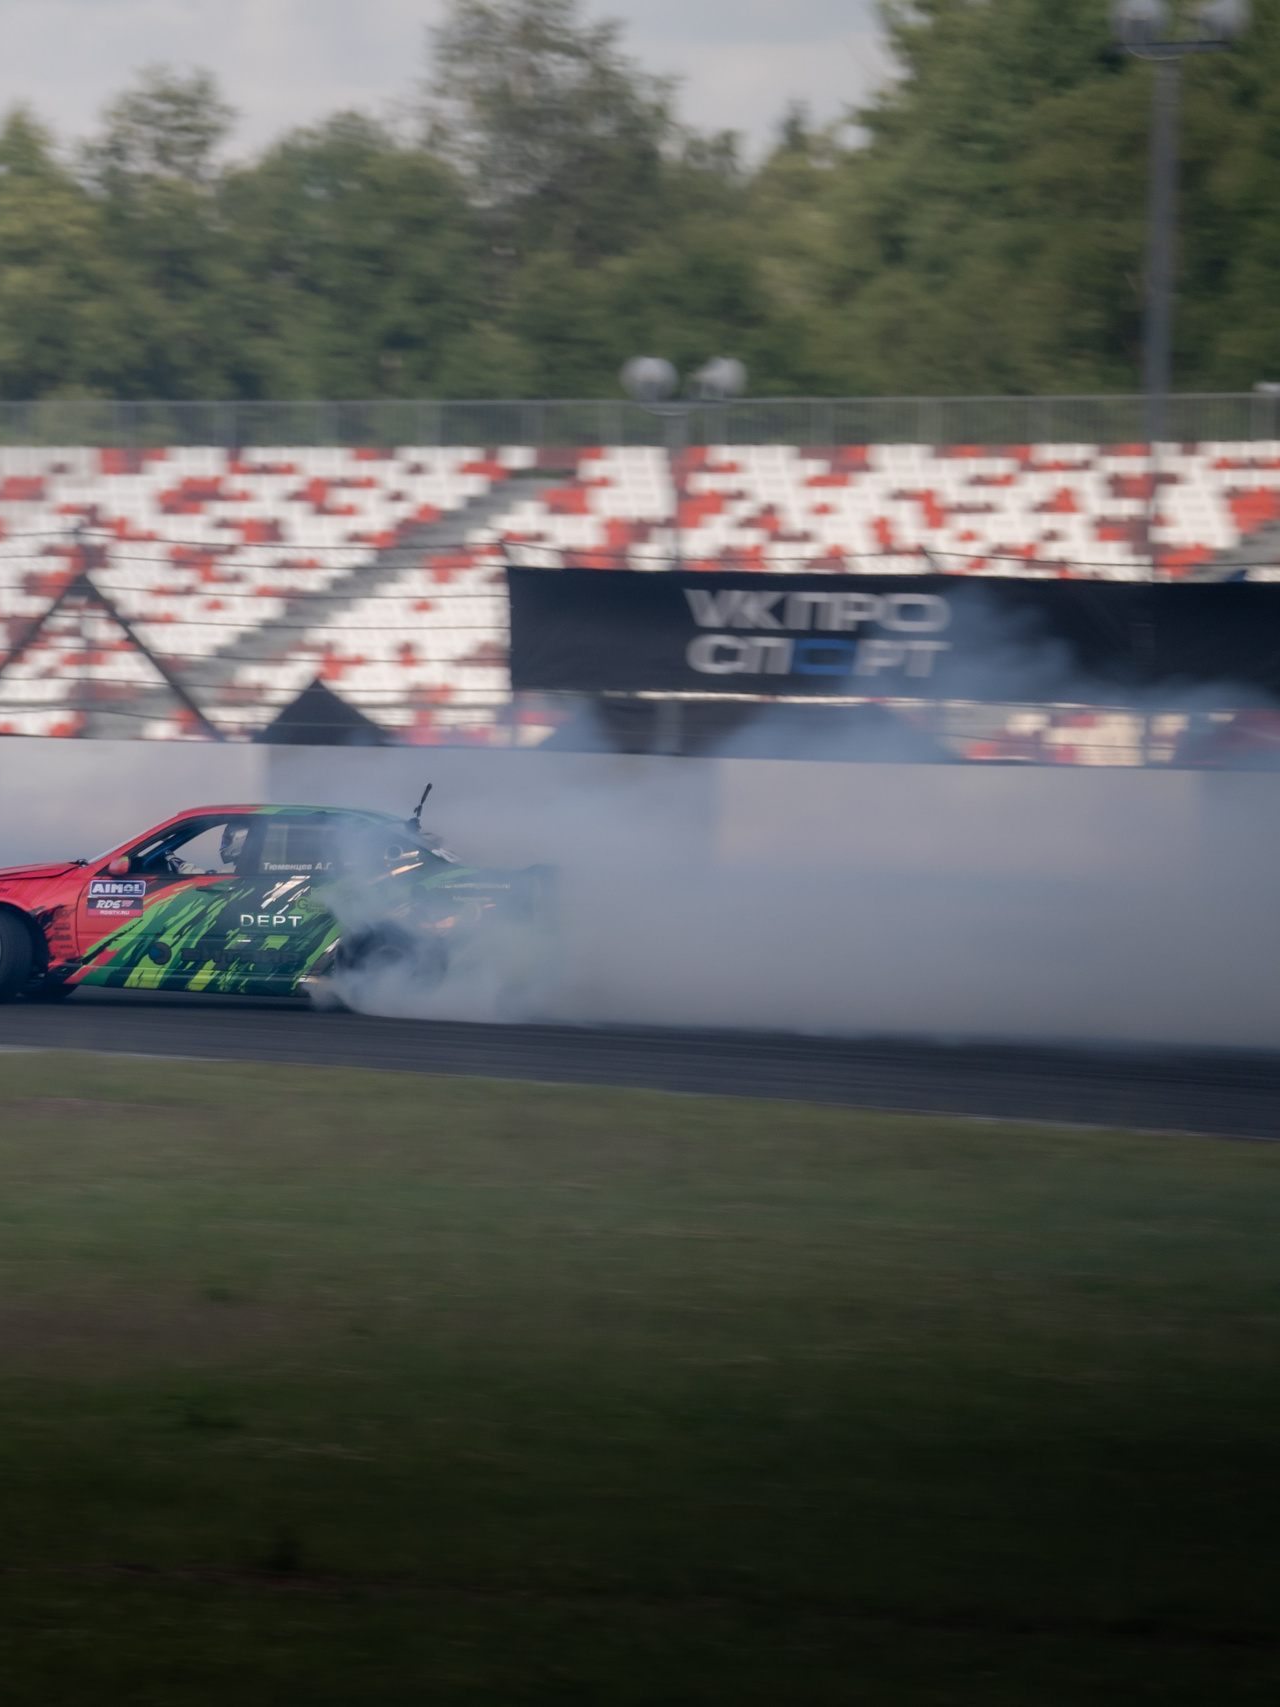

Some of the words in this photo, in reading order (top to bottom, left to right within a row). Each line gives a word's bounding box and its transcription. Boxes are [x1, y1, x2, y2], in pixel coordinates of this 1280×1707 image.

[685, 633, 953, 678] СПОРТ
[263, 862, 313, 871] Тюменцев
[92, 883, 143, 894] AIMOL
[95, 899, 122, 909] RDS
[240, 913, 303, 928] DEPT
